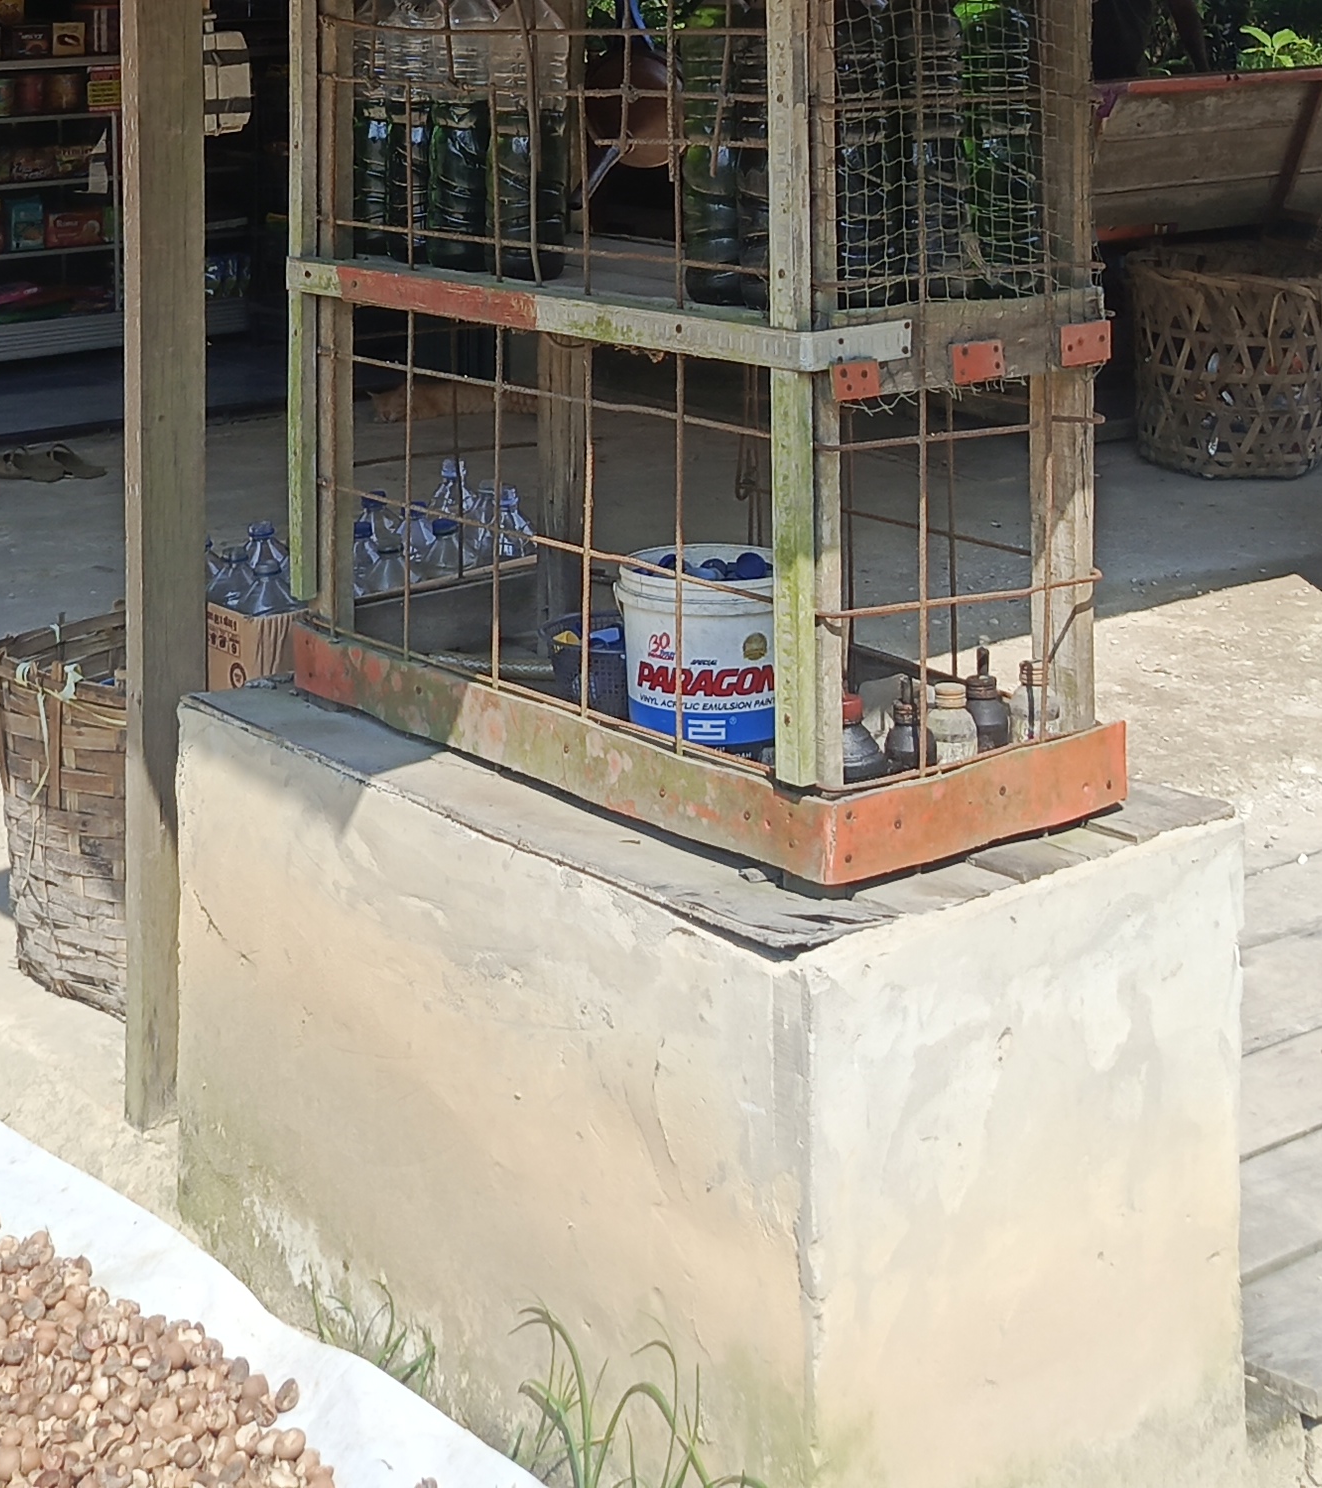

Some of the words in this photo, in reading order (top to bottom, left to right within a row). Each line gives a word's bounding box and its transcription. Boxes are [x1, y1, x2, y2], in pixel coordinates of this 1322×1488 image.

[637, 660, 775, 697] PARAGON
[639, 692, 659, 706] VINYL
[702, 700, 752, 711] EMULSION
